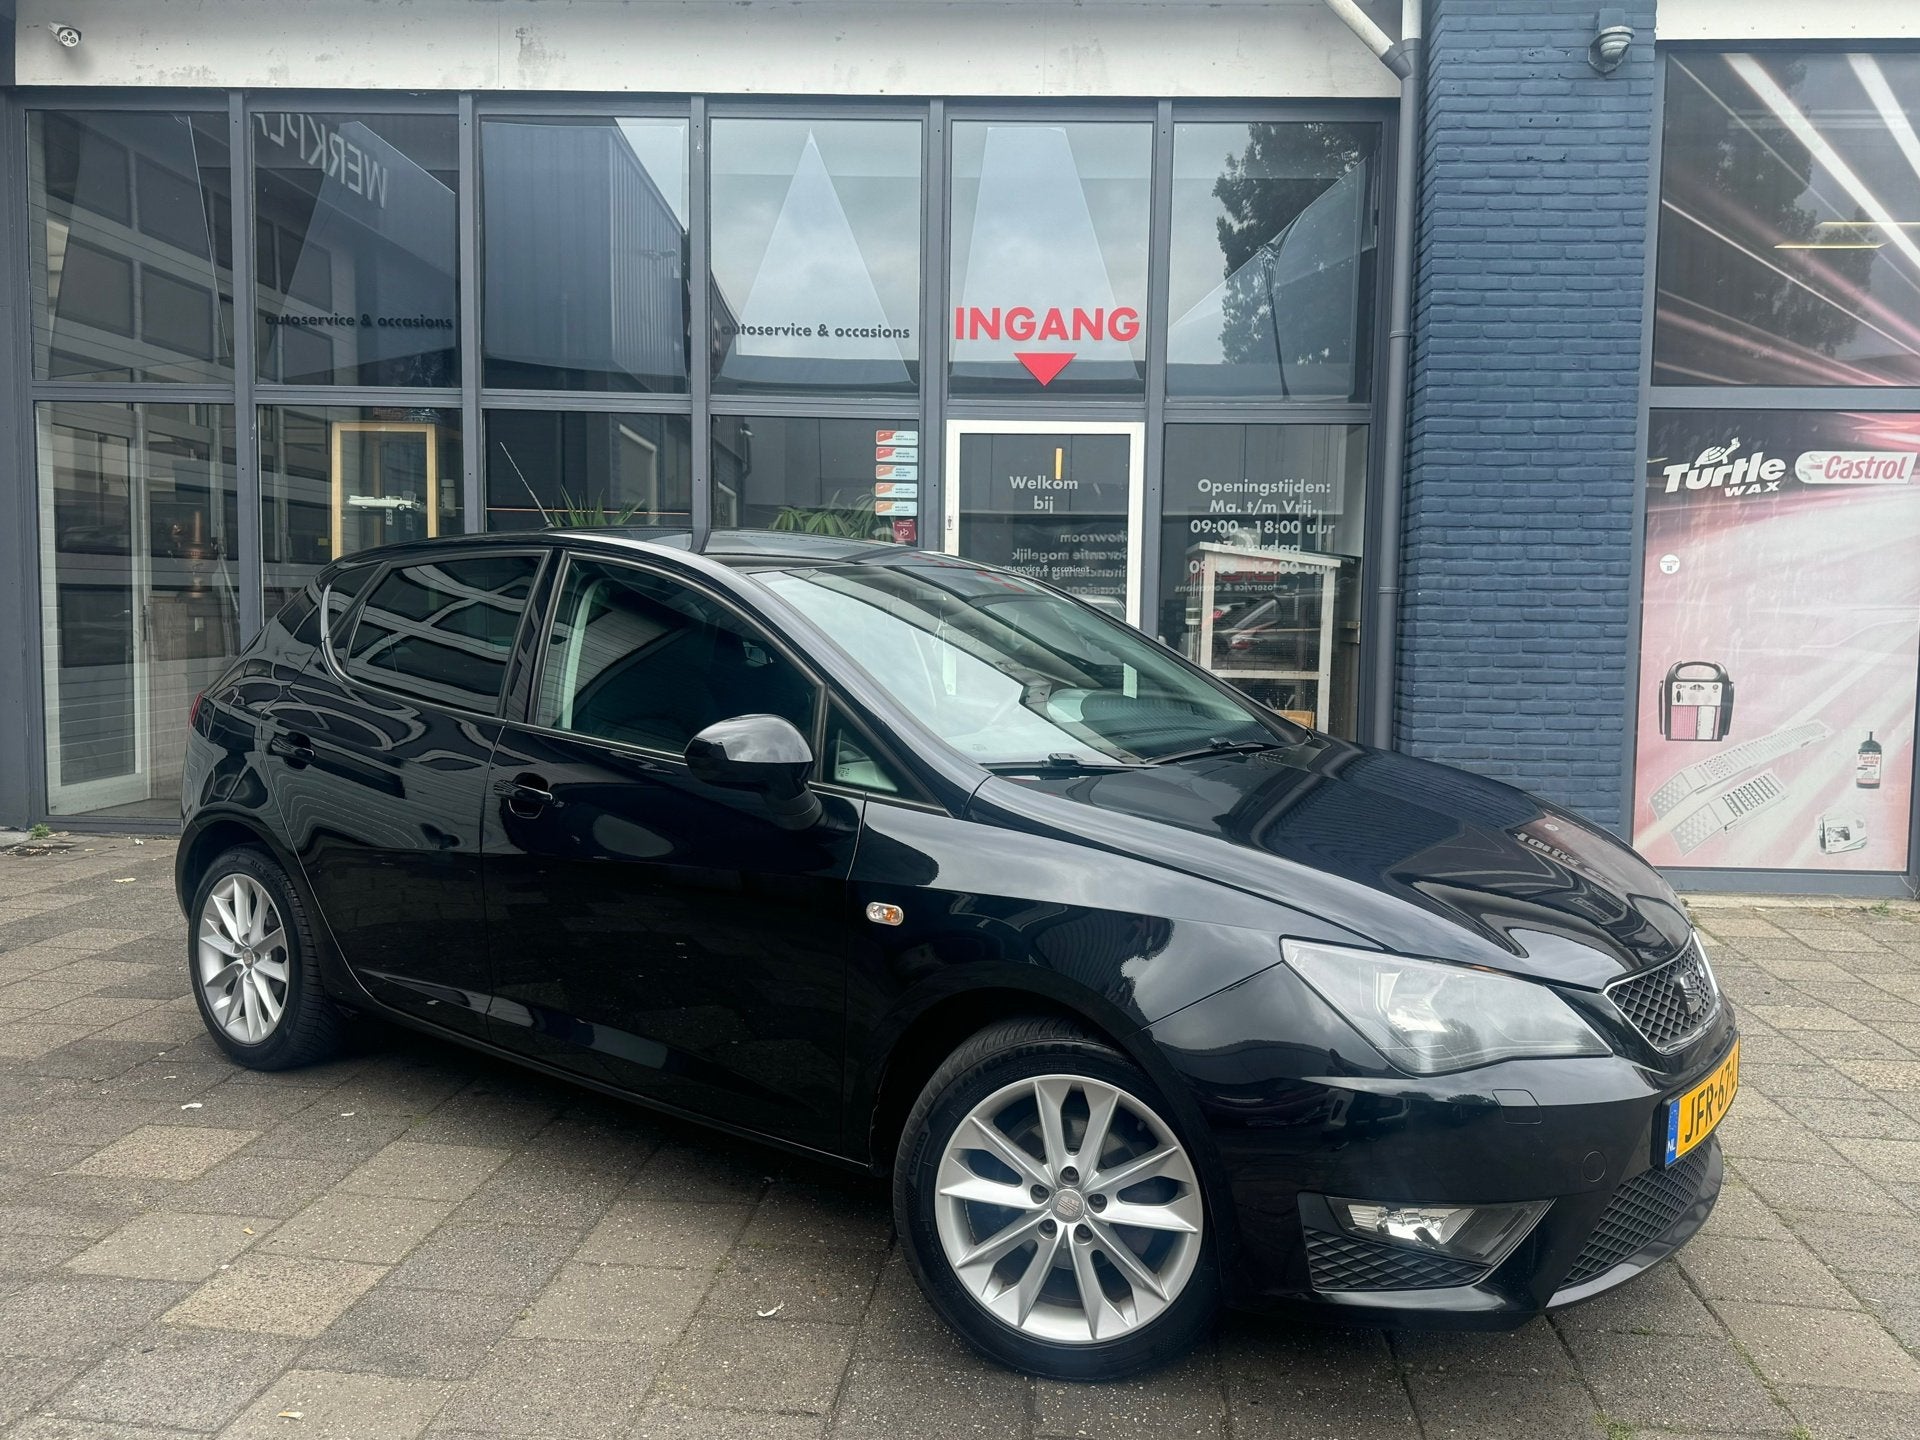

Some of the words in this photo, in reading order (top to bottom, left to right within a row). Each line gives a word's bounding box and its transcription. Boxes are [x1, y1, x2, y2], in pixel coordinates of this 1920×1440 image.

[265, 313, 355, 327] autoservice
[360, 314, 373, 327] &
[377, 314, 453, 329] occasions
[955, 306, 1140, 342] INGANG
[721, 323, 812, 337] autoservice
[818, 324, 829, 337] &
[834, 324, 910, 338] occasions
[1663, 452, 1786, 493] Turtle
[1824, 455, 1908, 480] Castrol
[1009, 475, 1079, 490] Welkom
[1197, 478, 1331, 496] Openingstijden:
[1724, 481, 1780, 498] WAX
[1033, 496, 1054, 514] bij
[1209, 500, 1242, 513] Ma.
[1247, 499, 1277, 515] t/m
[1282, 500, 1317, 517] Vrij.
[1190, 520, 1239, 534] 09:00
[1254, 520, 1301, 534] 18:00
[1306, 524, 1336, 534] uur
[1667, 1138, 1677, 1154] NL
